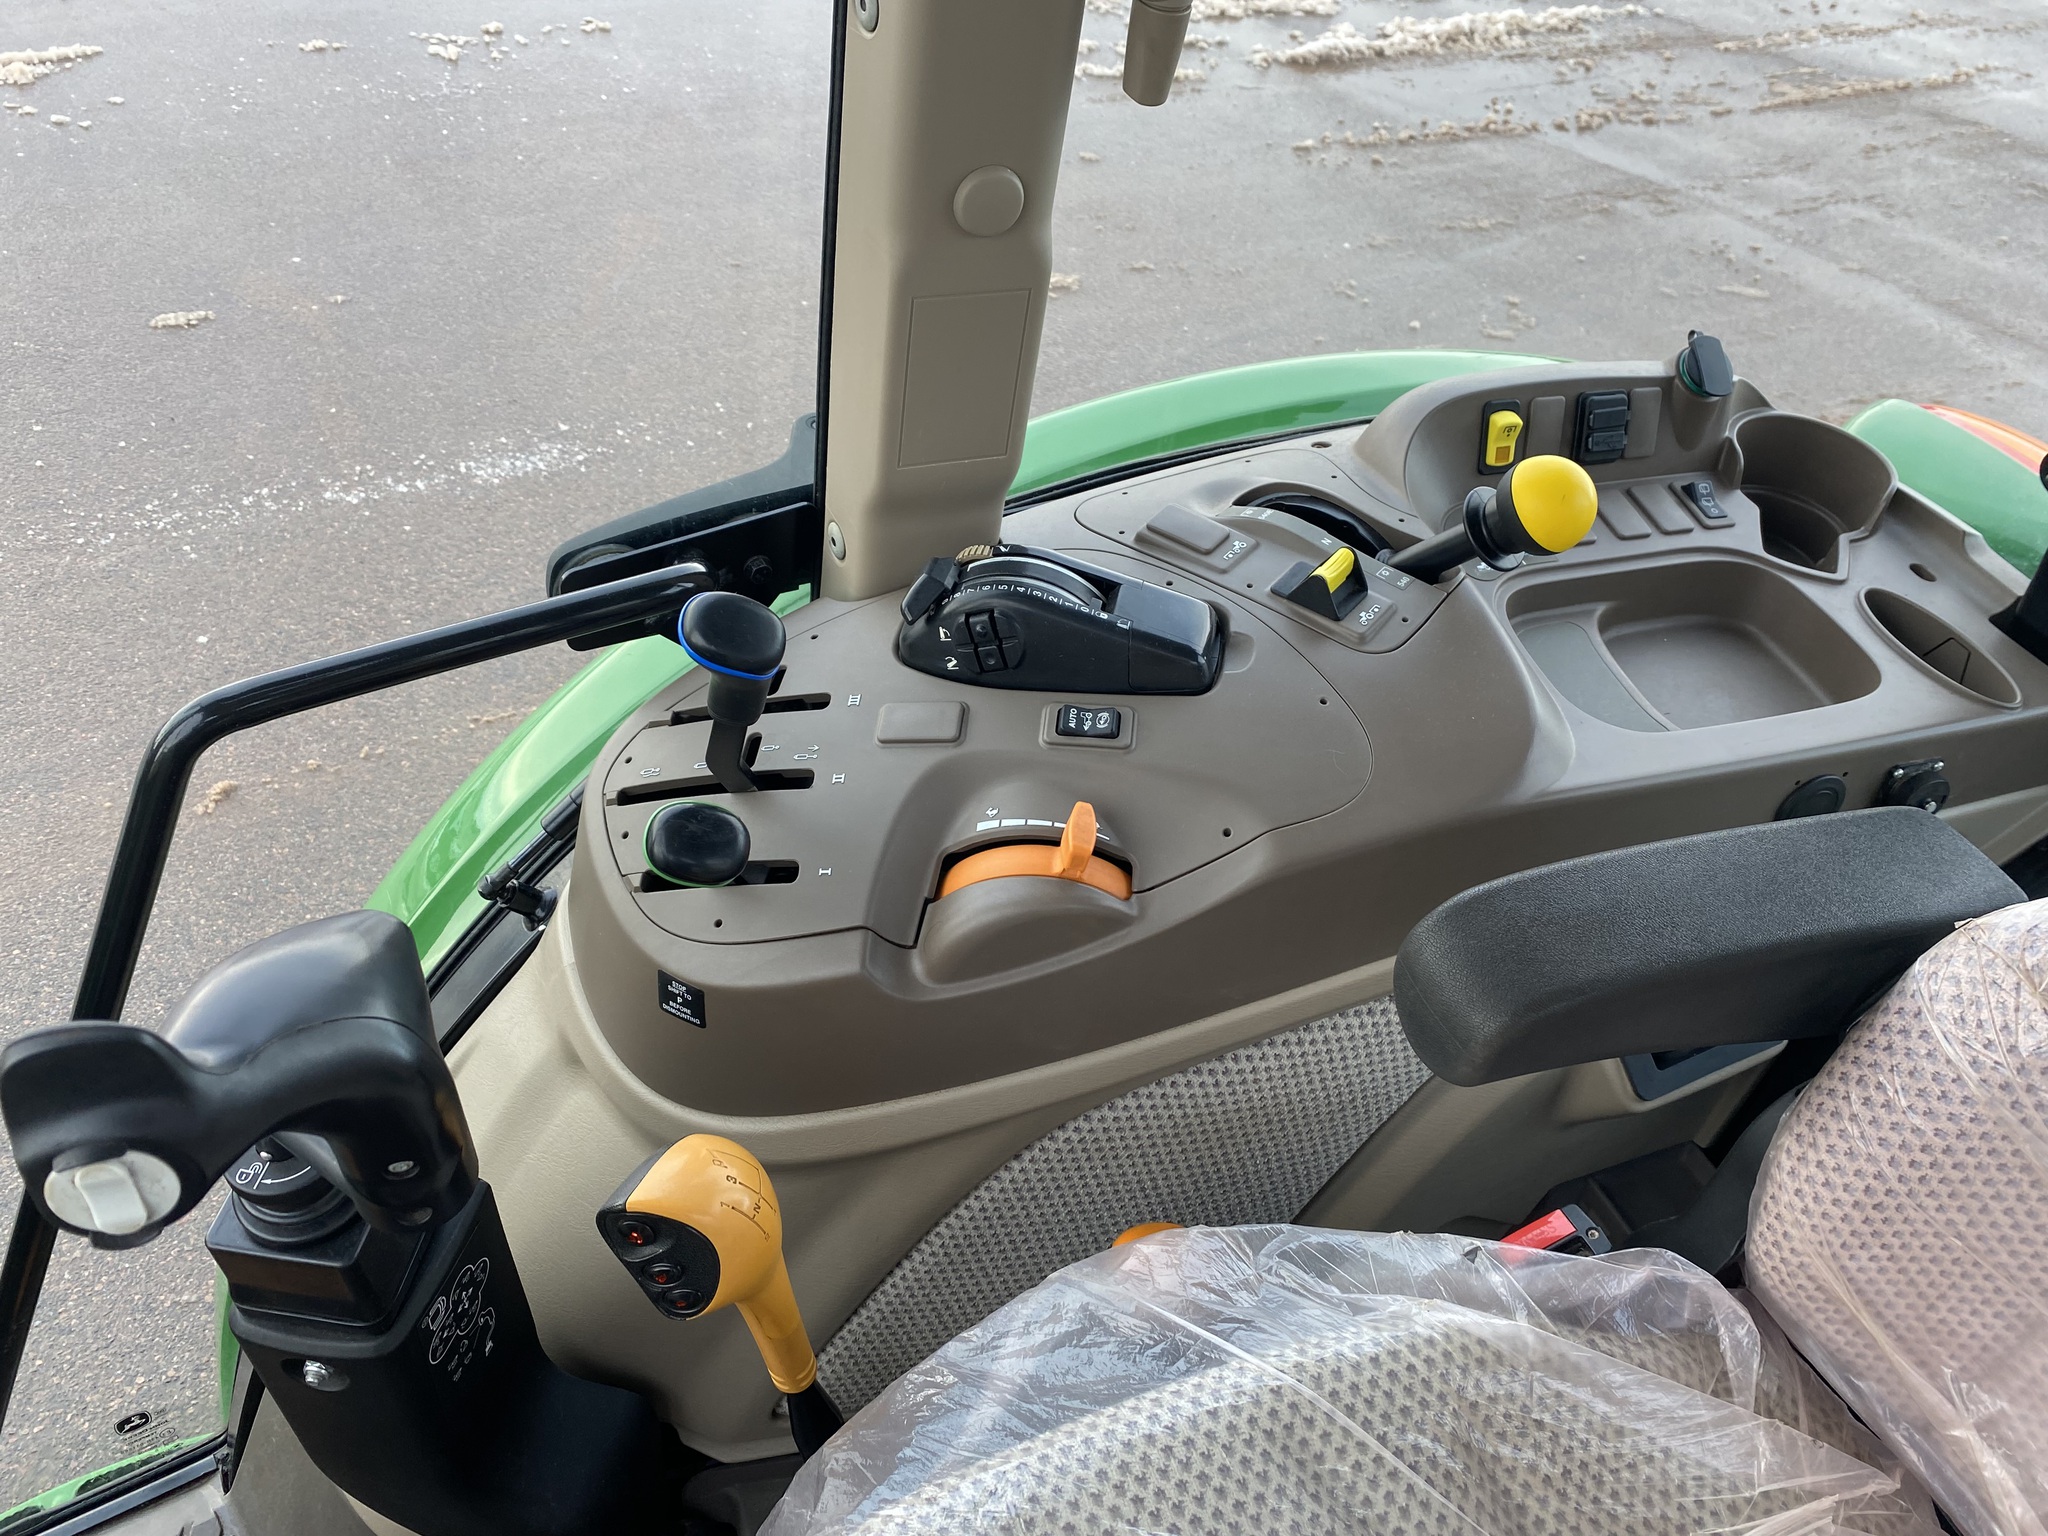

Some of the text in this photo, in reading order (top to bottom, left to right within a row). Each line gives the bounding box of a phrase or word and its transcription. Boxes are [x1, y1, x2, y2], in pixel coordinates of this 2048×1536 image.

[1321, 537, 1332, 545] N
[1397, 577, 1411, 587] 540
[1048, 595, 1059, 603] 2
[1068, 708, 1078, 729] AUTO
[672, 980, 687, 992] STOP
[662, 1003, 700, 1024] DISMOUNTING
[669, 1000, 691, 1015] BEFORE
[726, 1174, 737, 1184] 3
[753, 1202, 761, 1215] N
